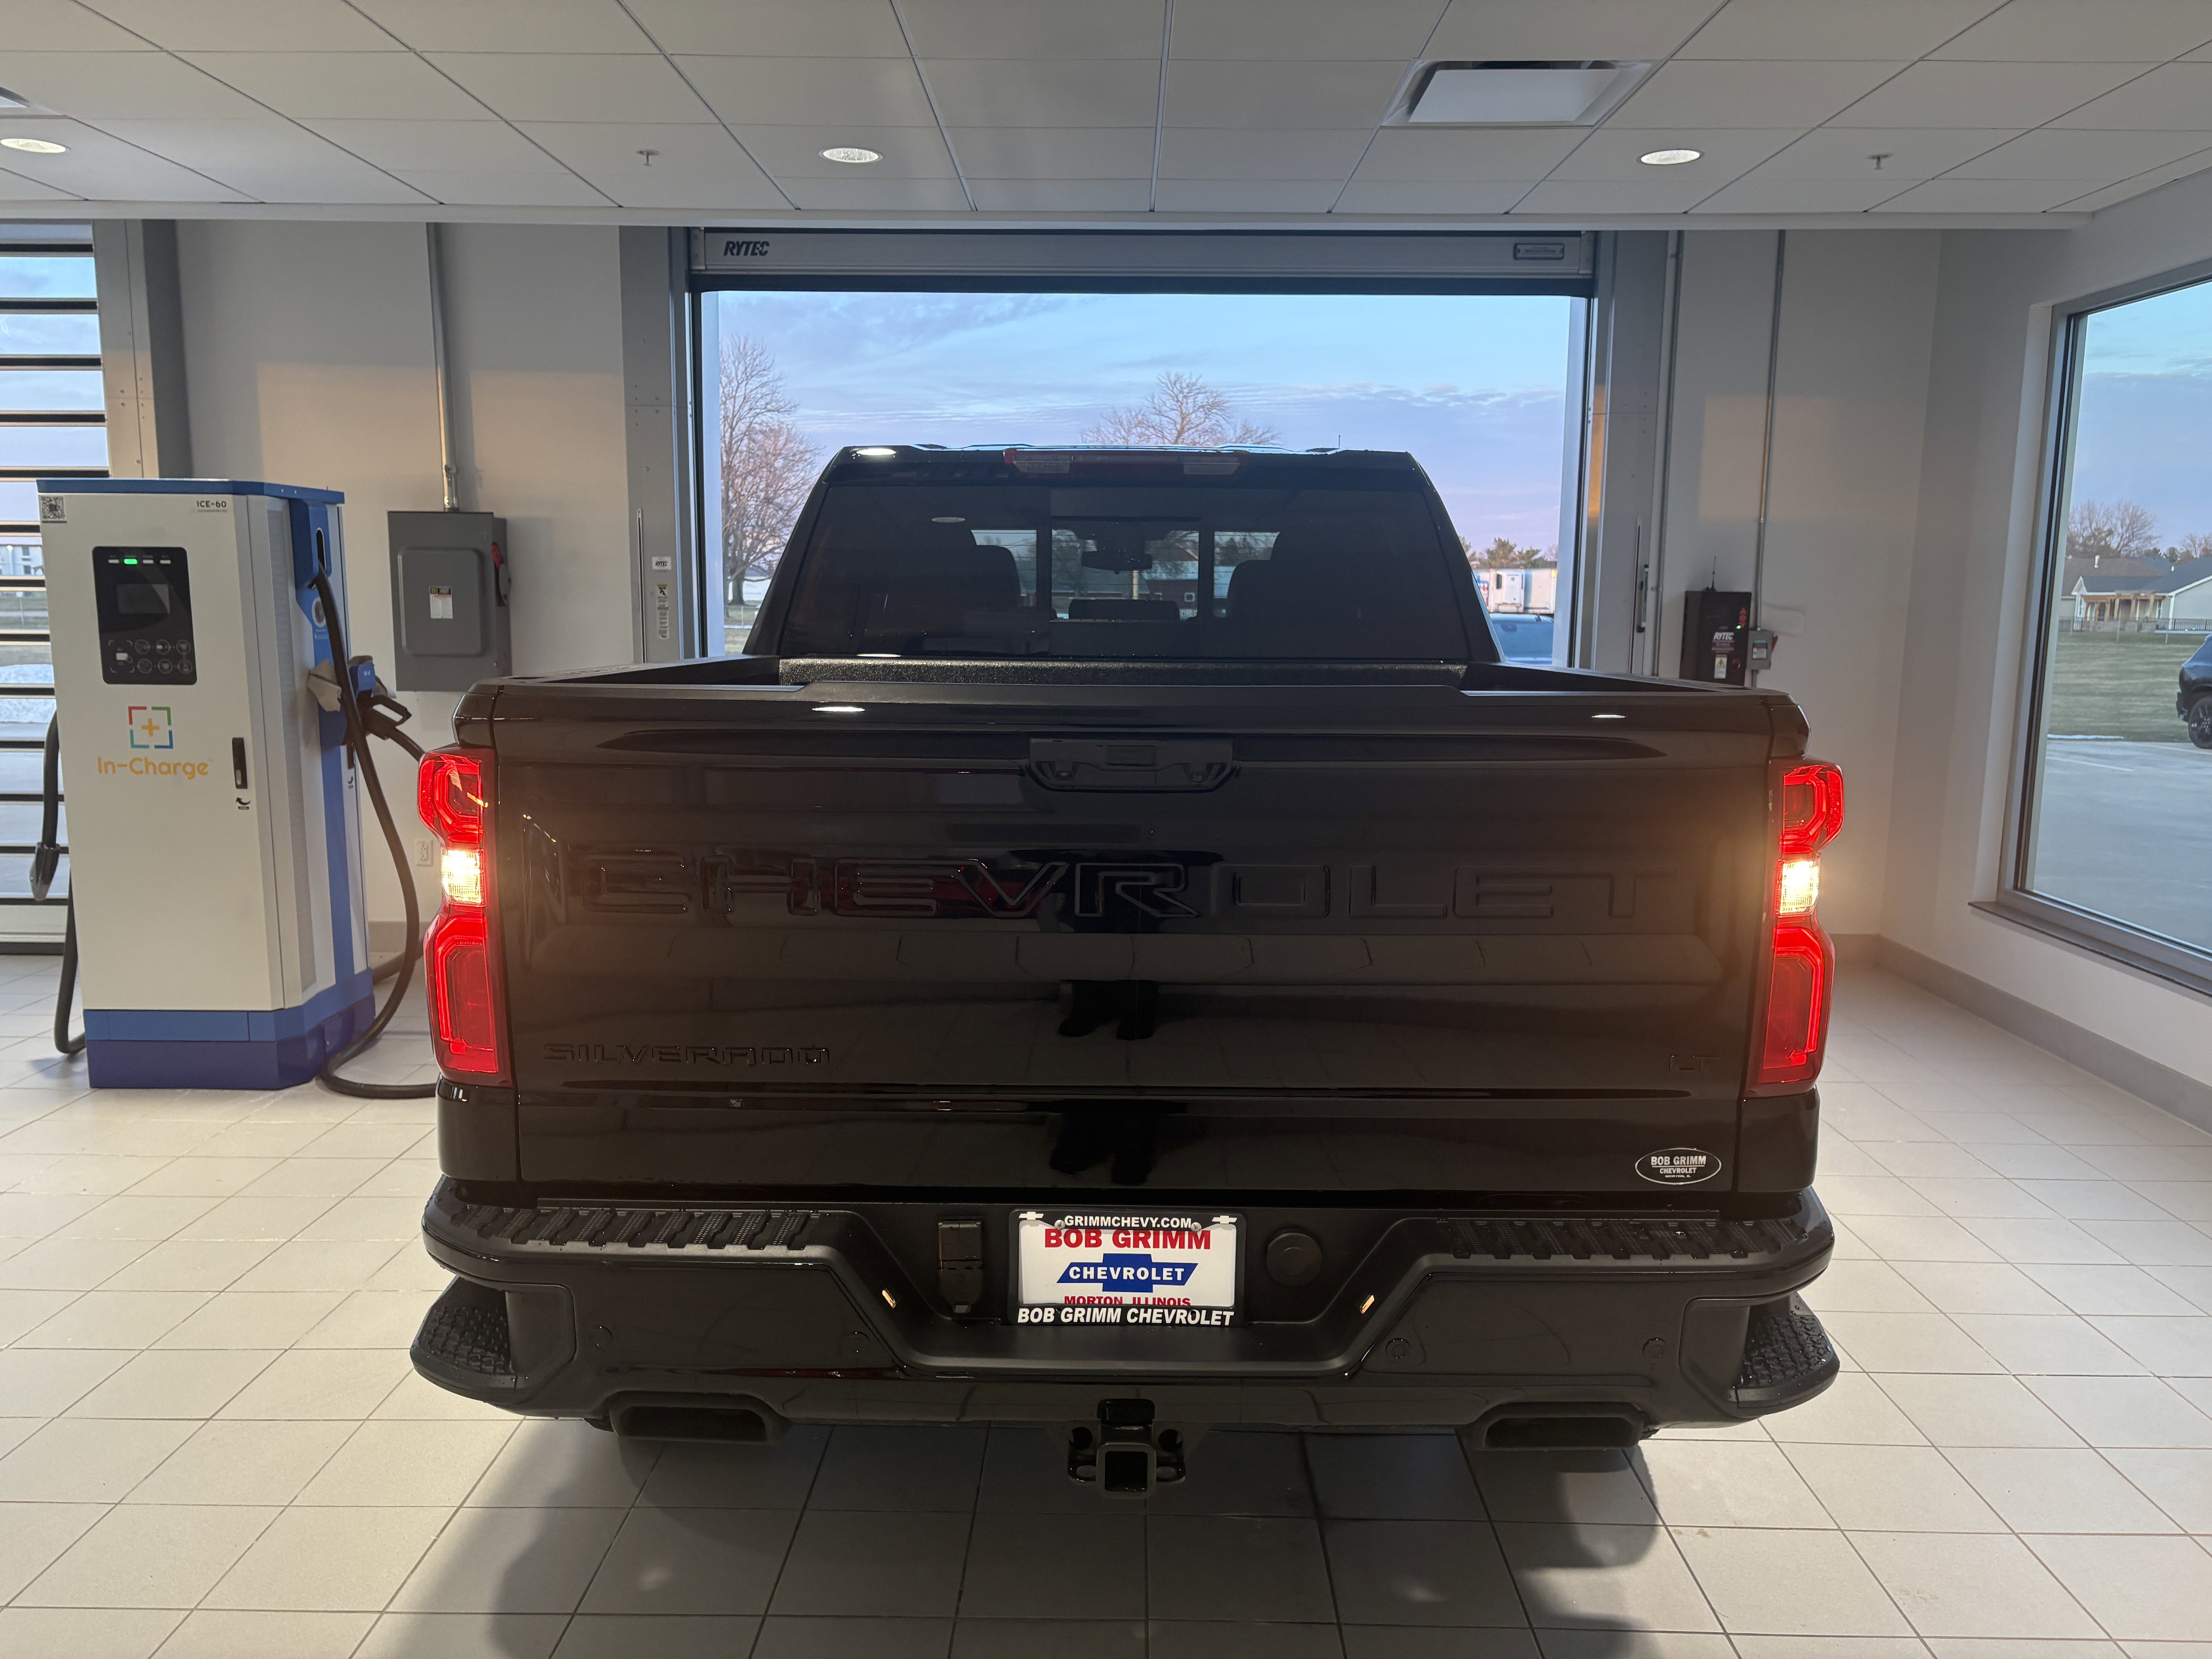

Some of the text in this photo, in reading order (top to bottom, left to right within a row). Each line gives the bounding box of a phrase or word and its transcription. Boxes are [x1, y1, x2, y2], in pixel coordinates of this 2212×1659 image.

[723, 241, 770, 256] RYTEC
[1713, 632, 1734, 641] RYTEC
[97, 756, 209, 780] In-Charge
[583, 854, 1676, 919] CHEVROLET
[544, 1044, 830, 1065] SILVERADO
[1651, 1156, 1707, 1166] BOB GRIMM
[1064, 1215, 1192, 1229] GRIMMCHEVY.COM
[1045, 1228, 1211, 1250] BOB GRIMM
[1069, 1266, 1185, 1281] CHEVROLET
[1064, 1296, 1123, 1305] MORTON
[1017, 1307, 1235, 1326] BOB GRIMM CHEVROLET
